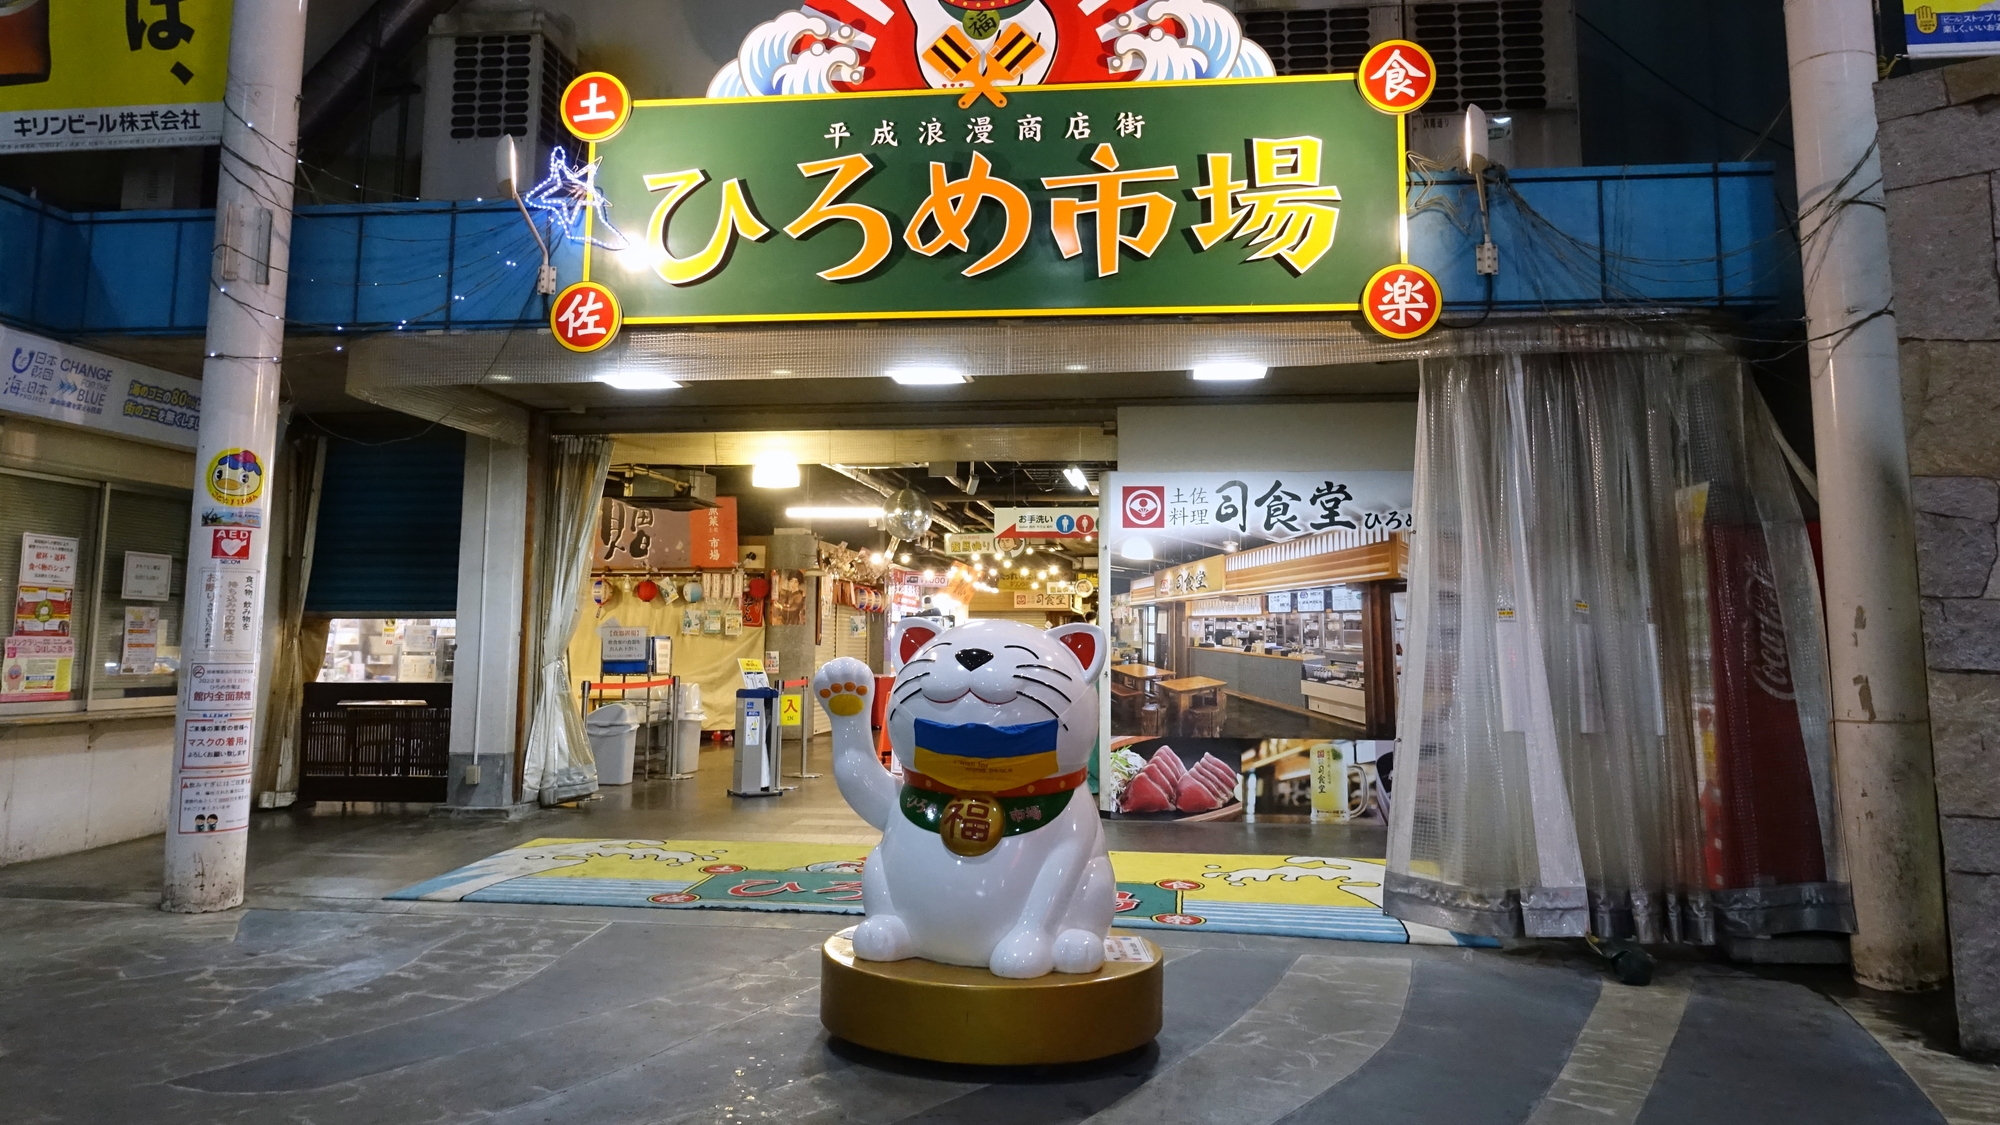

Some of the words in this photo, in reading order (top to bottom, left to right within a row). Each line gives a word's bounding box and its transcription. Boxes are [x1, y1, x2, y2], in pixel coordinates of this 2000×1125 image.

[1370, 49, 1426, 100] 食
[573, 83, 616, 123] 土
[14, 109, 202, 137] キリンビール株式会社
[824, 111, 1146, 149] 平成浪漫商店街
[643, 135, 1342, 285] ひろめ市場
[1377, 274, 1428, 327] 楽
[558, 292, 607, 338] 佐
[35, 352, 58, 366] 日本
[60, 358, 113, 382] CHANGE
[77, 388, 107, 407] BLUE
[1169, 487, 1209, 505] 土佐
[1215, 480, 1357, 533] 司食堂
[1018, 514, 1054, 524] お手洗い
[1169, 506, 1209, 526] 料理
[216, 530, 249, 539] AED
[708, 538, 721, 561] 市場
[1036, 593, 1067, 606] 司食堂
[193, 690, 252, 702] 館内全面禁煙
[784, 700, 798, 714] 入
[188, 736, 248, 747] マスクの着用を
[944, 797, 991, 842] 福
[1009, 805, 1042, 822] 市場
